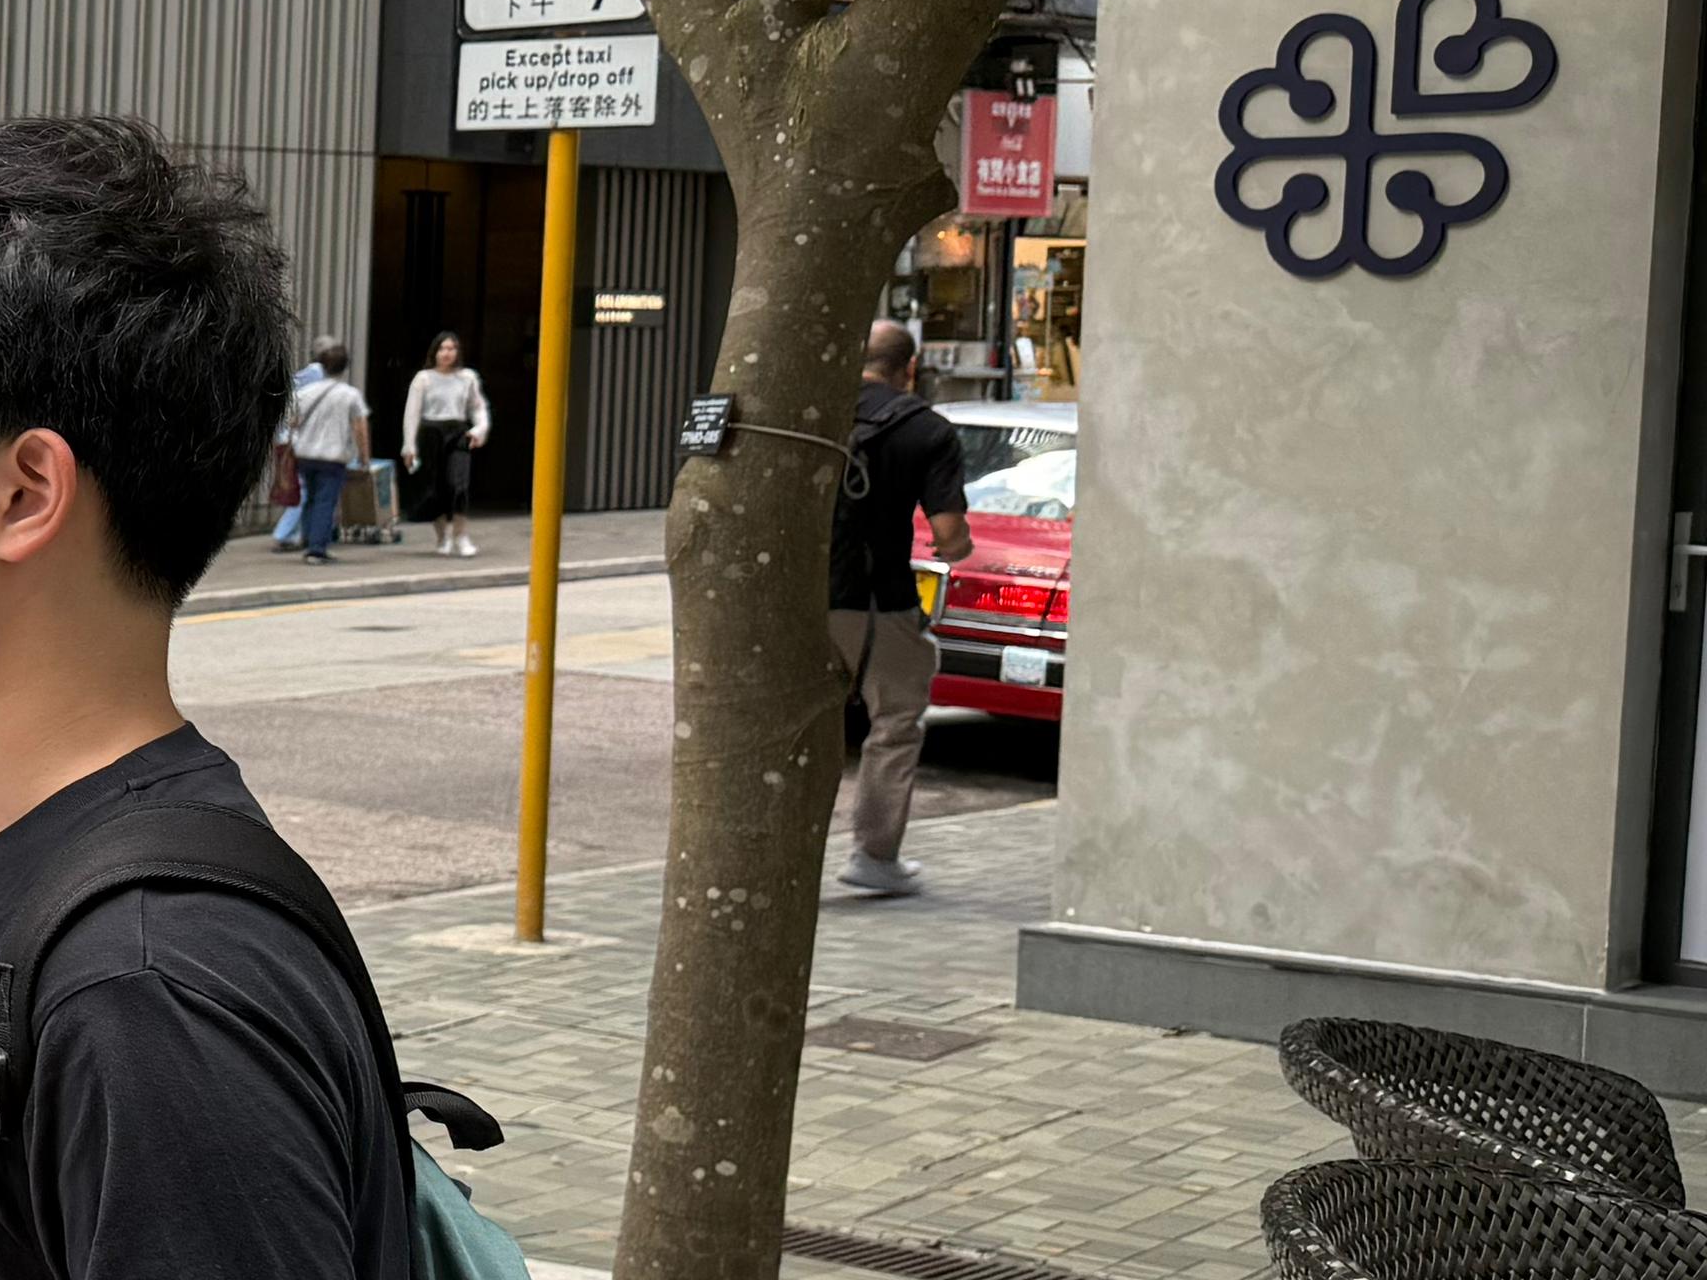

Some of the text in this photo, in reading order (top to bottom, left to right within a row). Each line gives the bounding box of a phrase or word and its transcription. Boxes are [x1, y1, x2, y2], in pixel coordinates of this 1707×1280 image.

[505, 45, 612, 68] Except taxi
[479, 67, 635, 93] pick up/drop off
[467, 93, 643, 121] 的士上落客除外
